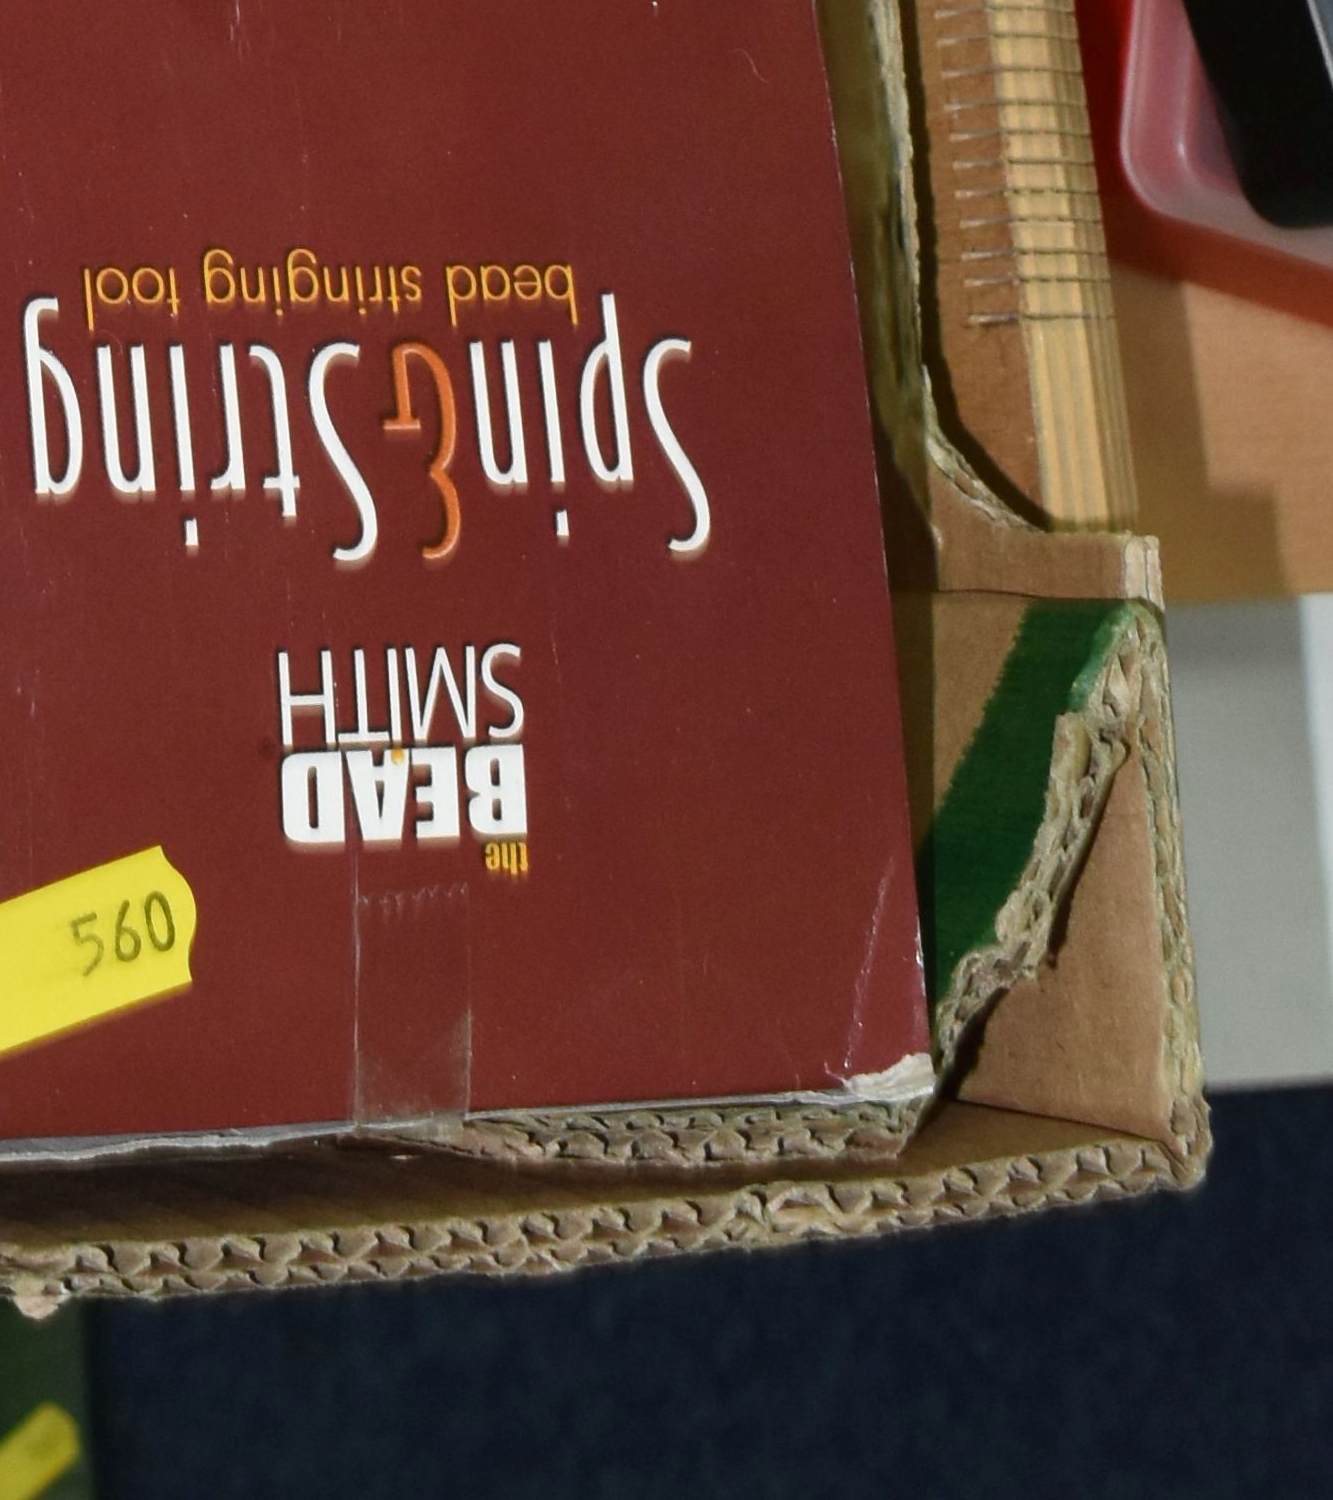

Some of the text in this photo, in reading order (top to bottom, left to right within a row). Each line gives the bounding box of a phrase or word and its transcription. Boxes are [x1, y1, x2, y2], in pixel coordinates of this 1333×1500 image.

[84, 248, 578, 332] bead stringing tool
[278, 642, 528, 738] SMITH
[280, 742, 529, 843] BEAD
[483, 839, 532, 878] the
[70, 890, 175, 976] 560
